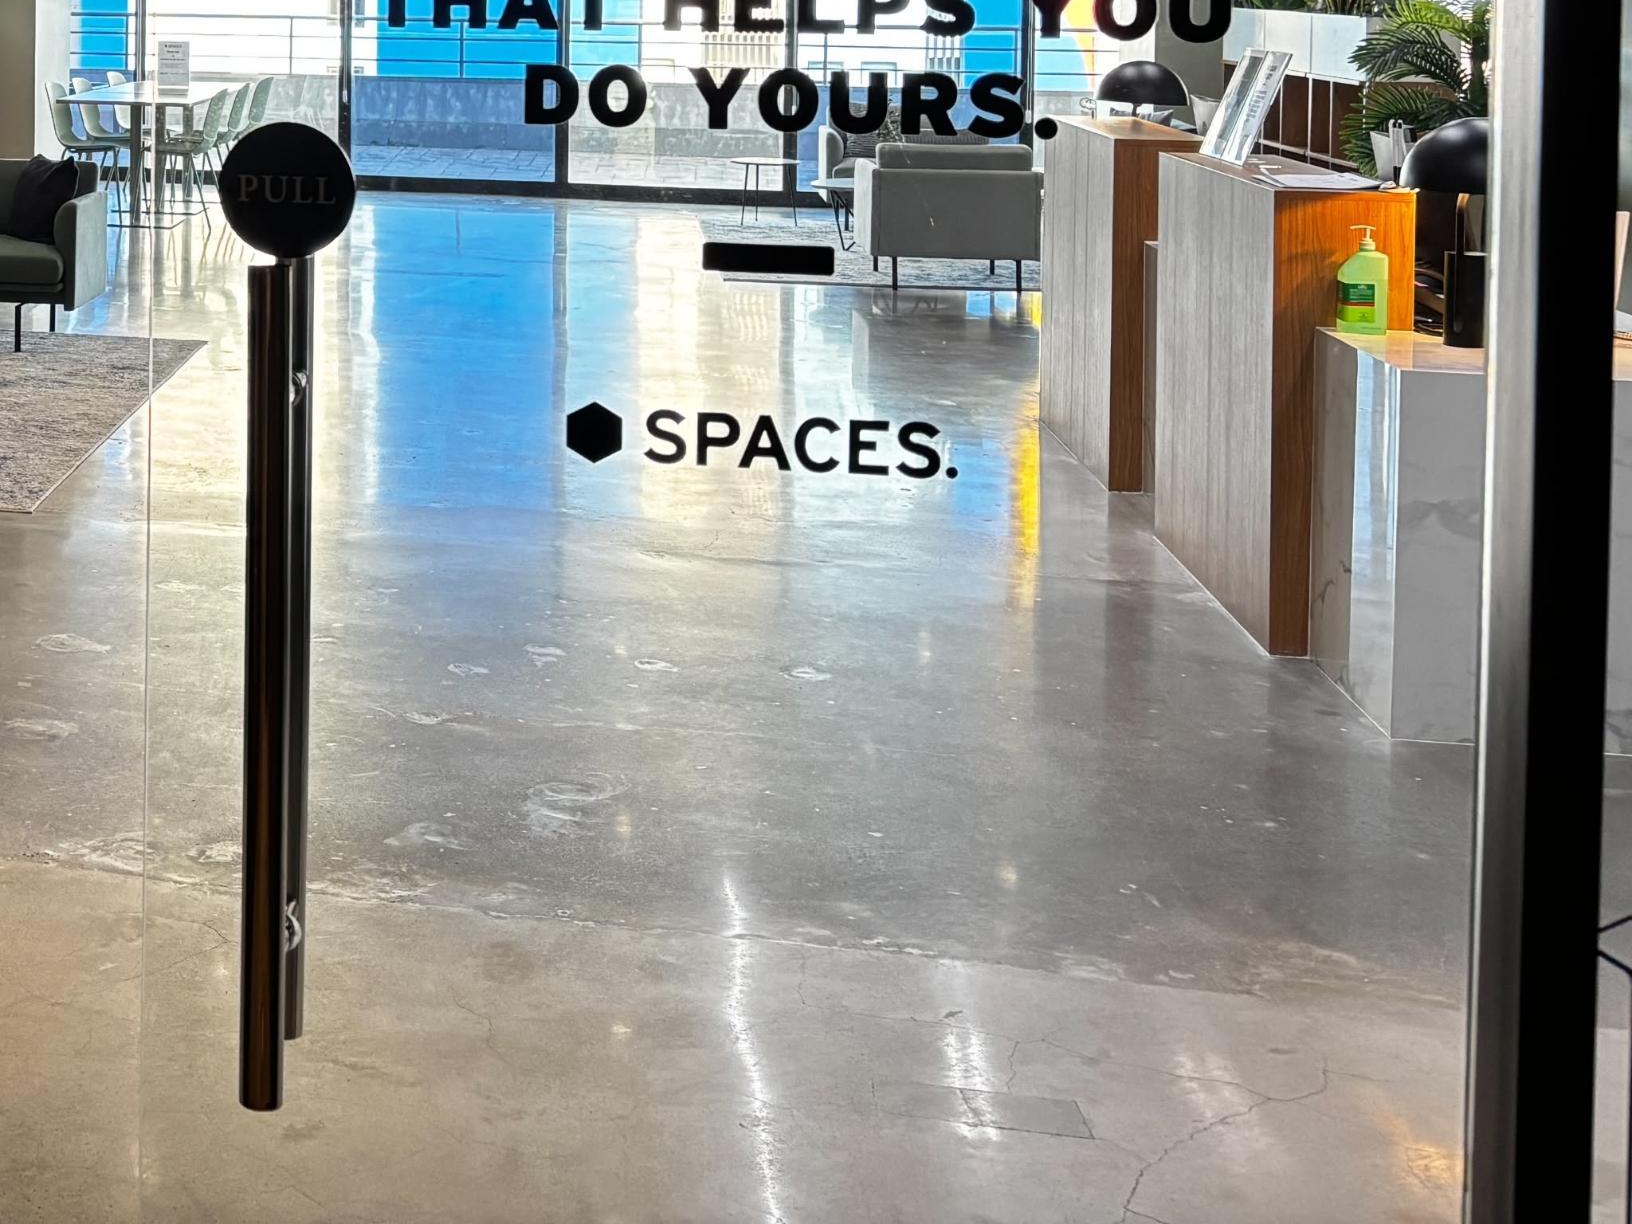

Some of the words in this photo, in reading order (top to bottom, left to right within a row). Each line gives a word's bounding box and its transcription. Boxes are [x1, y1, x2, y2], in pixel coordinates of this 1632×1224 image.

[525, 64, 648, 129] DO
[693, 66, 1058, 142] YOURS.
[238, 174, 337, 205] PULL
[643, 408, 958, 479] SPACES.
